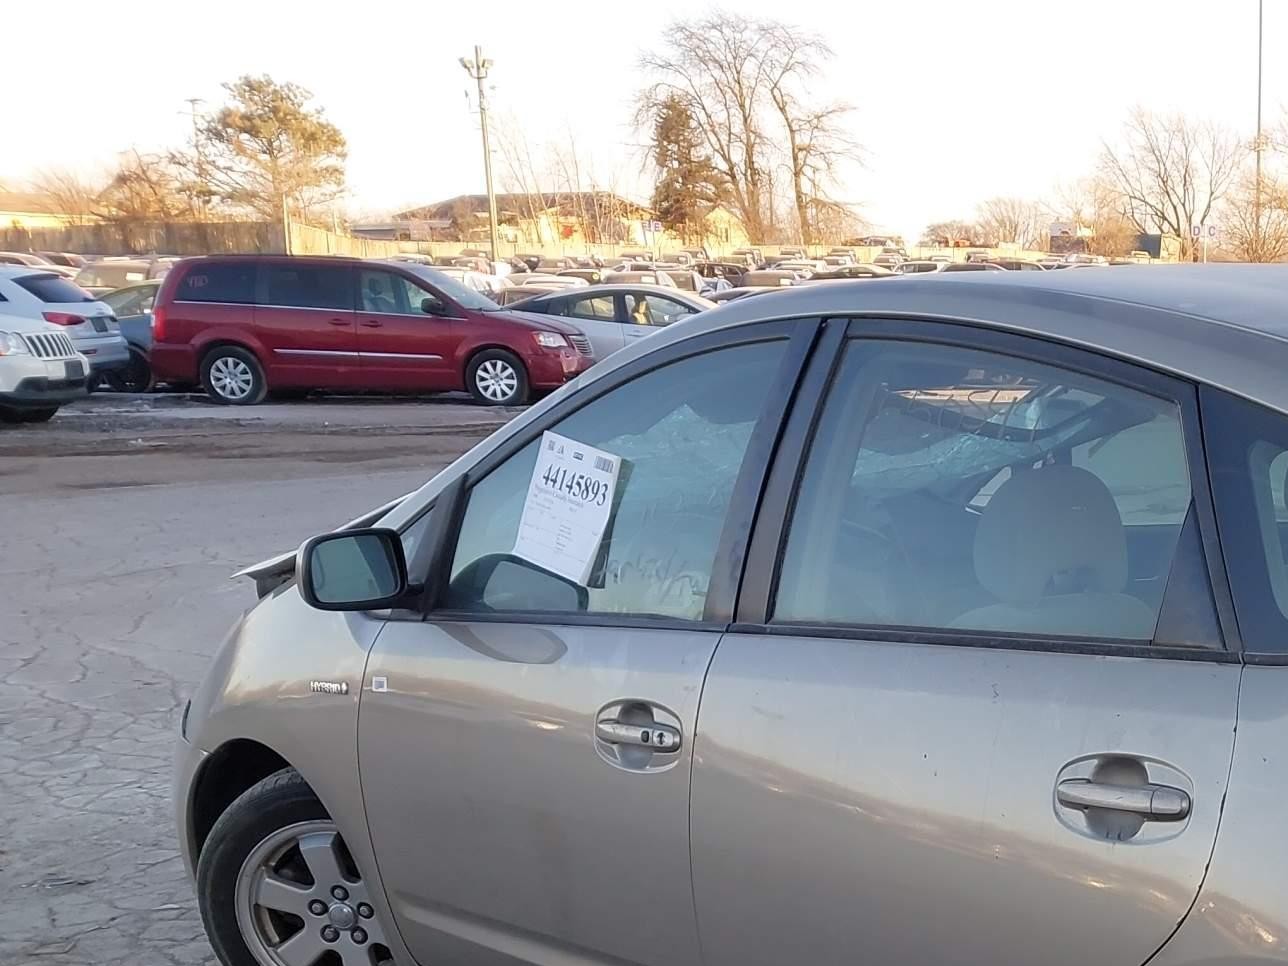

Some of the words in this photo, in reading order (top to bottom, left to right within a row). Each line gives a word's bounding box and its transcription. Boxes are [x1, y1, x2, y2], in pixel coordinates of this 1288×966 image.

[1193, 225, 1200, 236] D
[1208, 225, 1216, 236] C
[542, 464, 609, 506] 44145893
